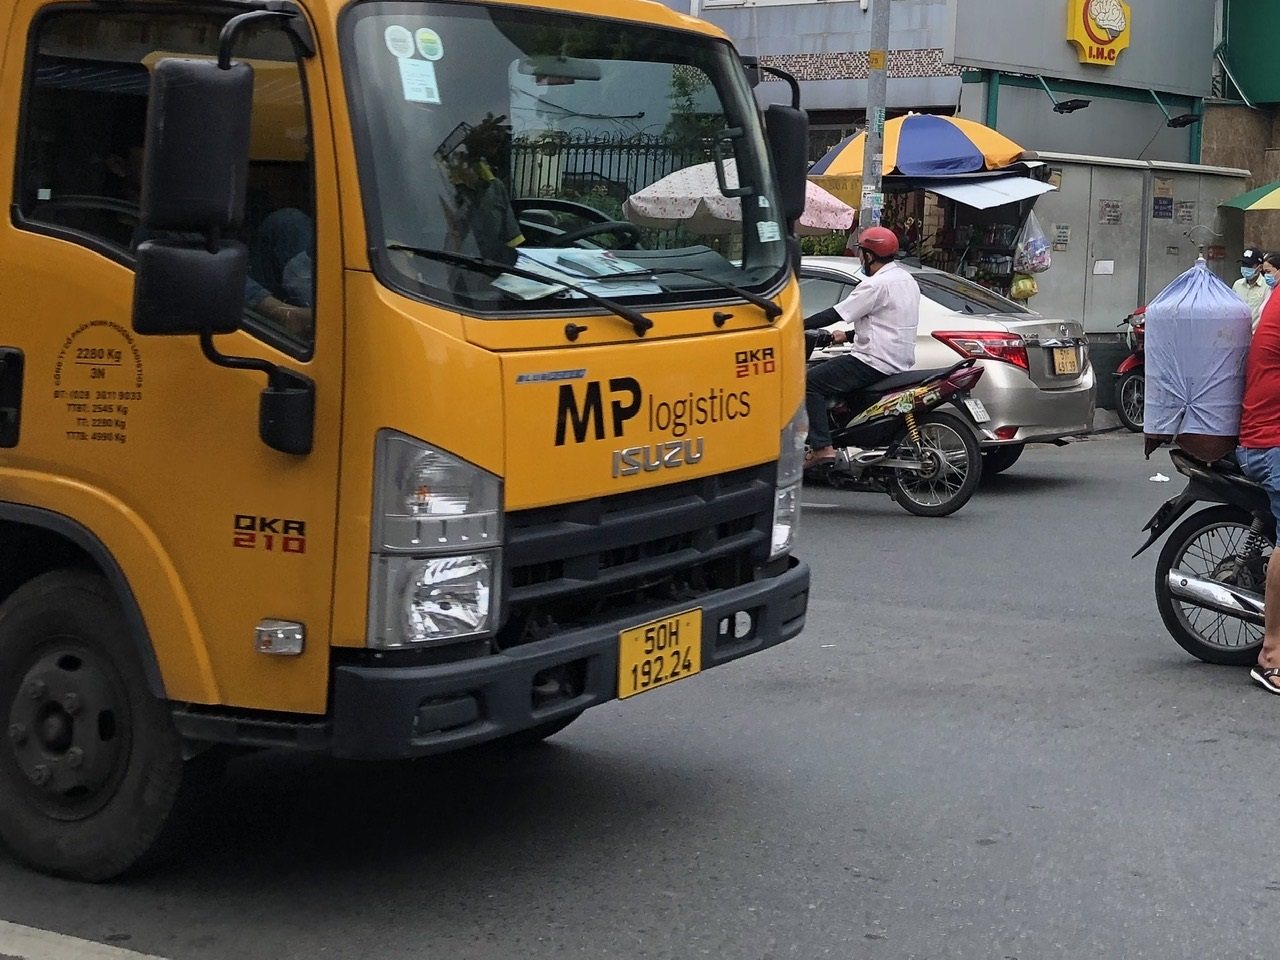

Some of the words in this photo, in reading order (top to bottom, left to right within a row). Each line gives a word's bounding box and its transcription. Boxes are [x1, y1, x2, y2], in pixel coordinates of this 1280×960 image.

[76, 348, 104, 359] 2280
[106, 348, 122, 362] Kg
[735, 347, 774, 365] QKR
[736, 360, 775, 379] 210
[554, 377, 642, 446] MP
[649, 388, 751, 437] logistics
[612, 436, 704, 478] ISUZU
[234, 514, 306, 536] QKR
[233, 531, 306, 553] 210
[644, 619, 679, 655] 50H
[631, 646, 692, 690] 192.24
